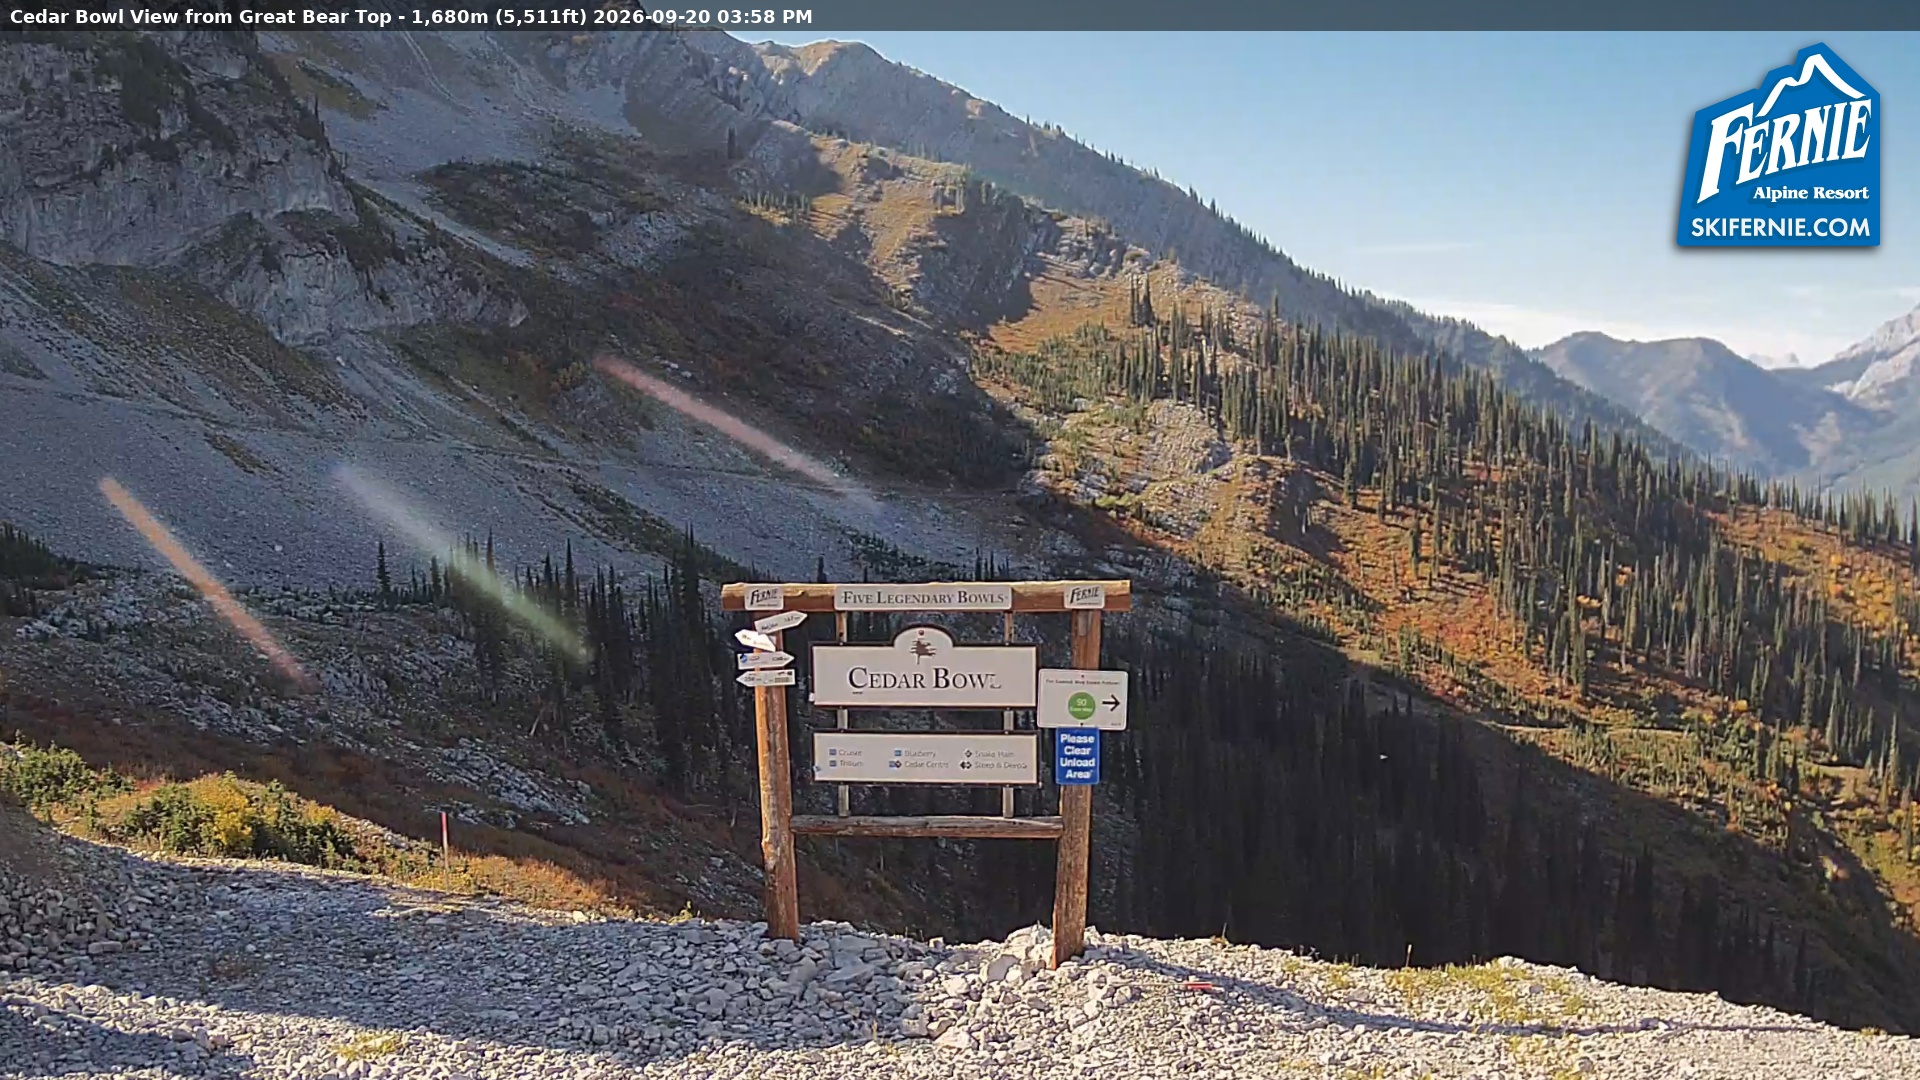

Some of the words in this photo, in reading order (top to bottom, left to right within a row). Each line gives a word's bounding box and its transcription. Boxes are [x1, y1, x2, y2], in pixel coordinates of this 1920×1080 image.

[843, 590, 873, 604] FIVE
[877, 591, 954, 604] LEGENDARY
[957, 590, 1004, 604] BOWLS
[848, 667, 926, 689] CEDAR
[1060, 734, 1095, 744] Please
[1064, 746, 1092, 755] Clear
[1060, 758, 1095, 767] Unload
[1065, 769, 1091, 779] Area
